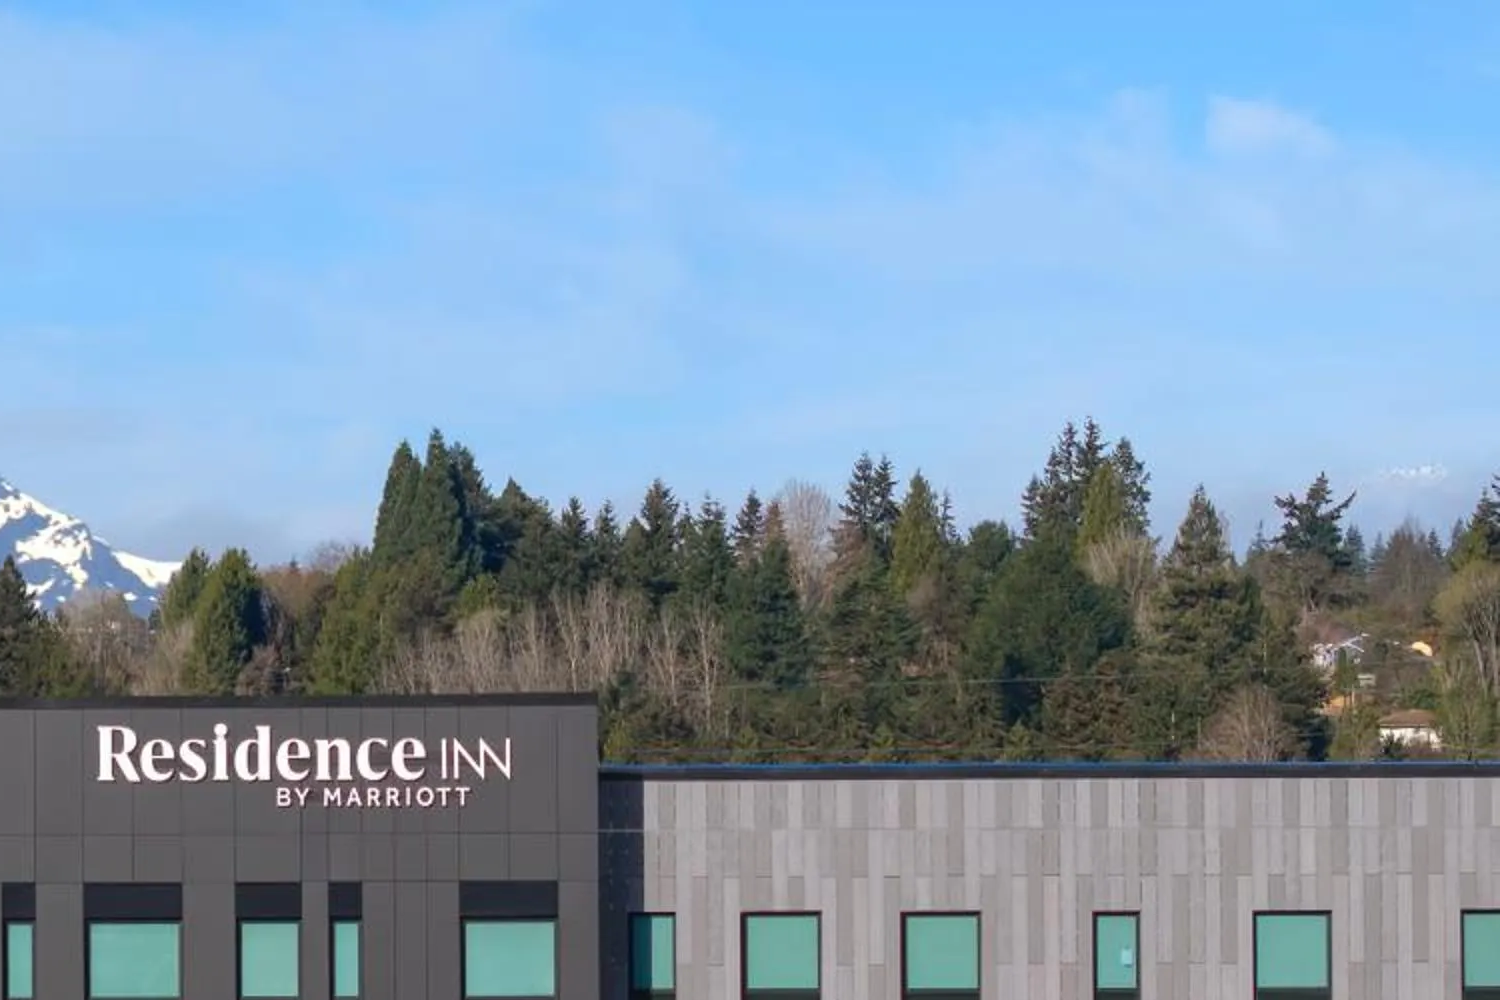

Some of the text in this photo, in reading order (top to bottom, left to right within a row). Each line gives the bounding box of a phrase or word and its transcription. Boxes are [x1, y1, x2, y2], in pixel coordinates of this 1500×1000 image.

[96, 722, 512, 783] Residence INN
[276, 786, 472, 807] BY MARRIOTT
